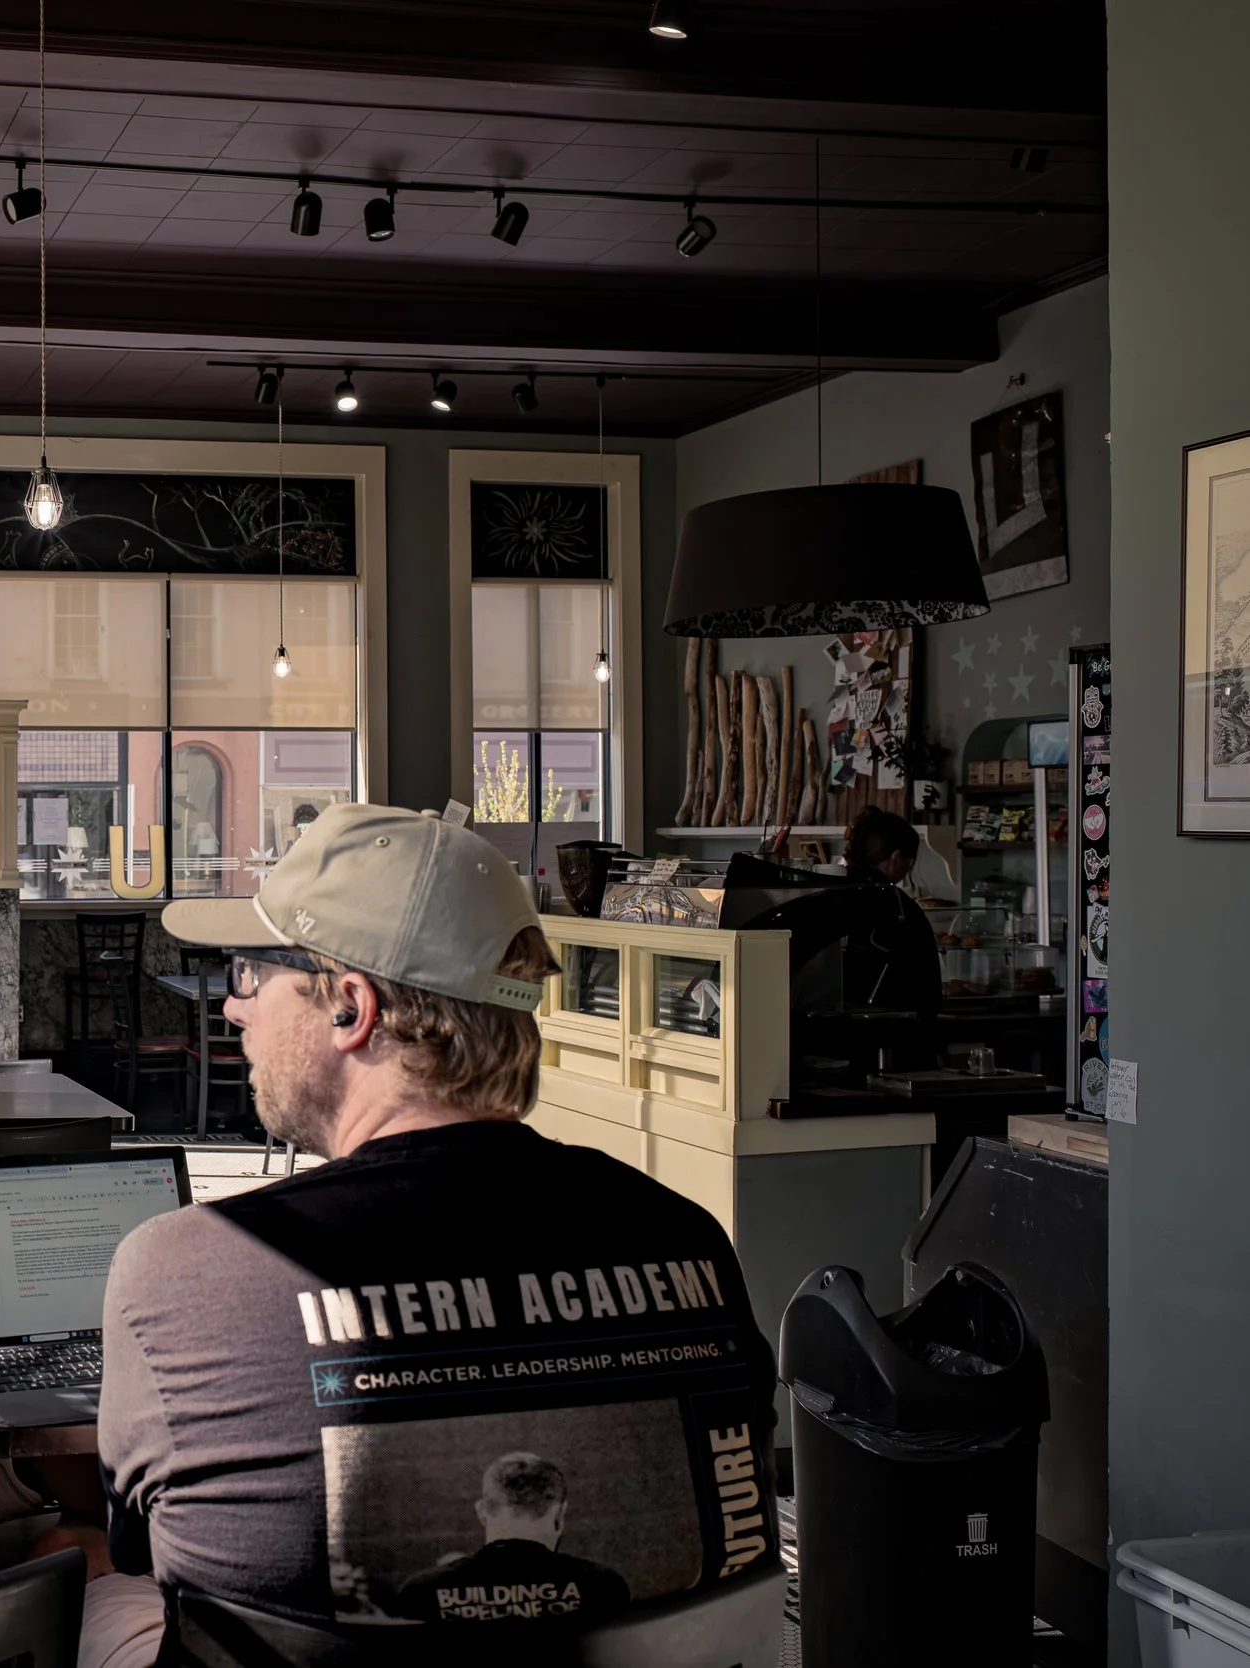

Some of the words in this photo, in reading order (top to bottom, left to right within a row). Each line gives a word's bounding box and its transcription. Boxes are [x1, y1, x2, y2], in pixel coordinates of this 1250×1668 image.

[109, 824, 166, 900] U
[1083, 1060, 1108, 1077] RIVER
[297, 1277, 498, 1346] INTERN
[518, 1259, 726, 1324] ACADEMY
[353, 1365, 487, 1391] CHARACTER.
[492, 1353, 616, 1379] LEADERSHIP.
[621, 1342, 723, 1367] MENTORING.
[955, 1543, 998, 1557] TRASH
[436, 1583, 558, 1609] BUILDING
[561, 1582, 581, 1600] A
